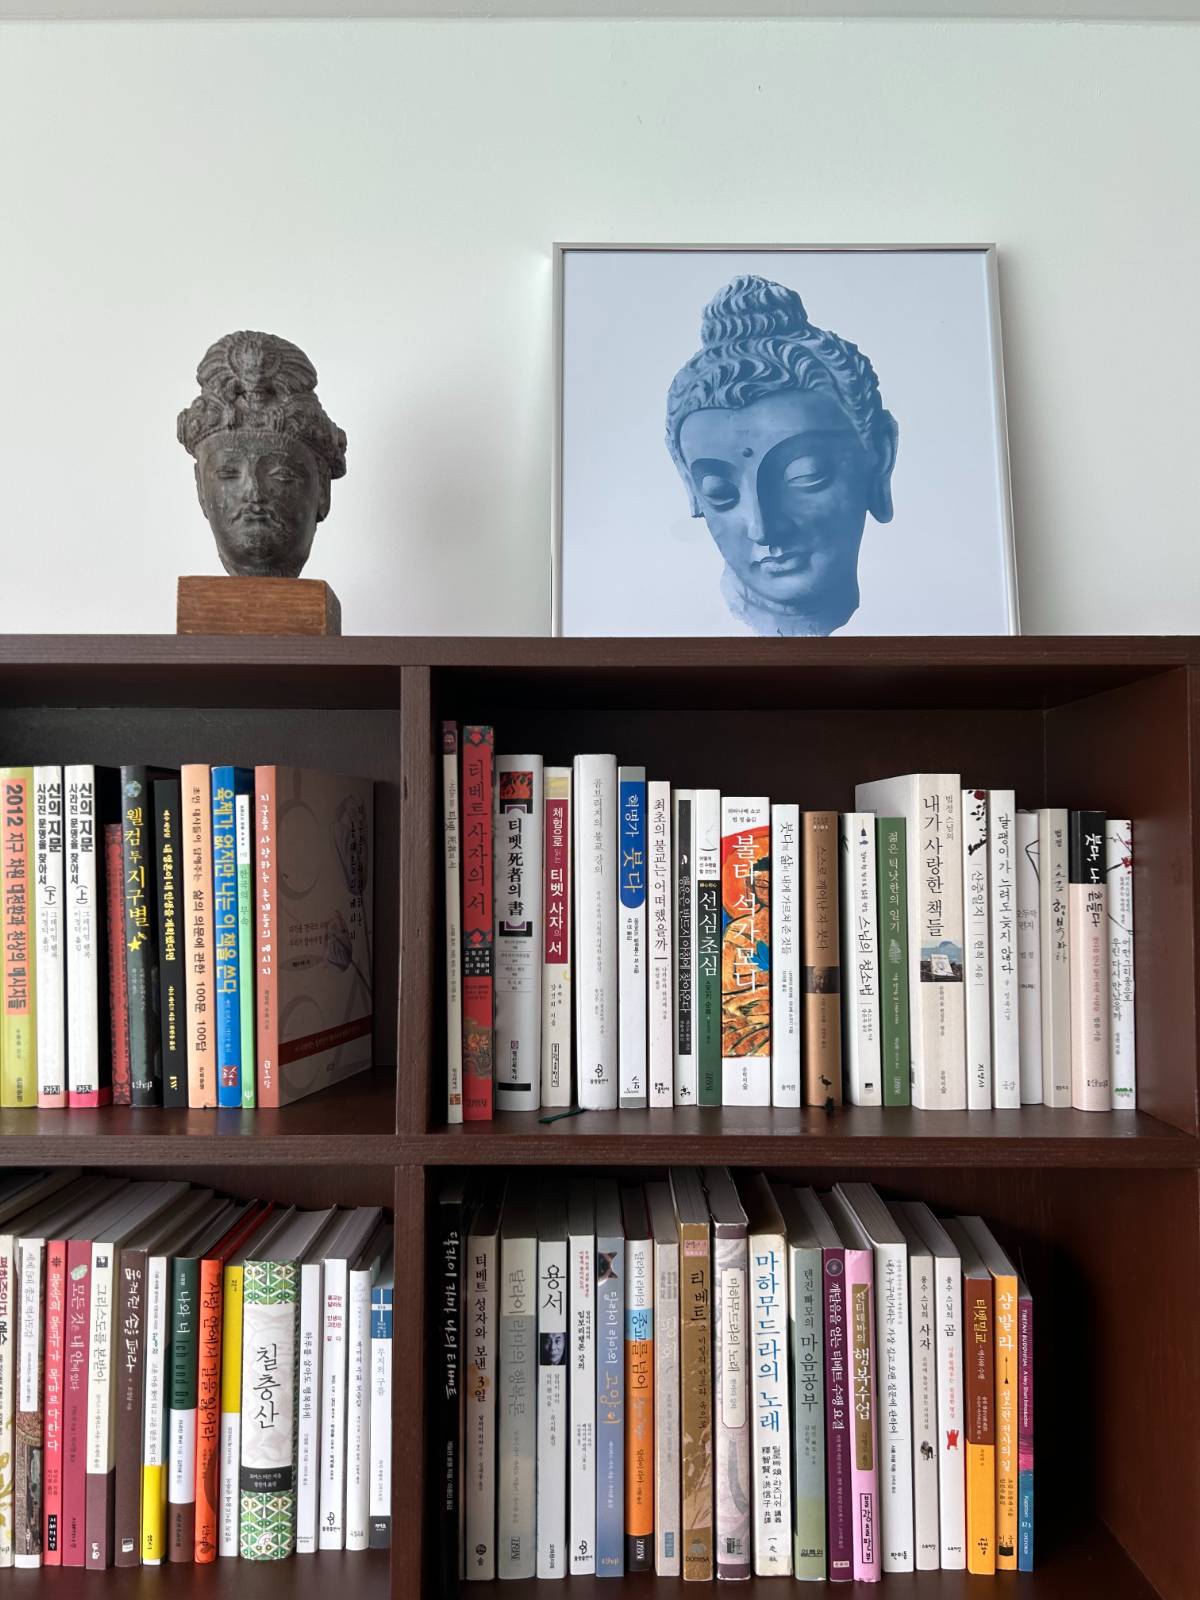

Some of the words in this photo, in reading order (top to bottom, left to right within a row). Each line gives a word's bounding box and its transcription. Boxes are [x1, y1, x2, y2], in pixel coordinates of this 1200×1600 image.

[37, 784, 47, 815] 사라진
[47, 783, 61, 817] 신의
[69, 783, 78, 815] 사라진
[78, 783, 93, 816] 신의
[467, 759, 489, 817] 티베트
[6, 784, 24, 827] 2012
[214, 788, 234, 828] 육체가
[625, 794, 639, 837] 혁명가
[653, 798, 665, 836] 최초의
[923, 794, 942, 832] 내가
[5, 832, 24, 853] 지구
[38, 818, 47, 850] 문명을
[48, 819, 62, 853] 지문
[70, 818, 78, 850] 문명을
[80, 819, 93, 853] 지문
[508, 818, 522, 850] 티벳
[552, 808, 563, 846] 체험으로
[998, 812, 1012, 874] 달팽이가
[214, 834, 236, 878] 없지만
[467, 822, 488, 886] 사자의
[653, 840, 667, 876] 불교는
[889, 832, 898, 855] 젊은
[1085, 833, 1102, 863] 붓다,
[5, 858, 25, 879] 차원
[38, 853, 47, 885] 찾아서
[70, 853, 79, 885] 찾아서
[162, 854, 174, 880] 영혼이
[507, 852, 524, 898] 死者의
[623, 847, 643, 893] 붓다
[732, 834, 760, 886] 불타
[780, 854, 793, 872] 삶이
[924, 837, 944, 894] 사랑한
[164, 882, 174, 890] 내
[216, 882, 236, 912] 나는
[551, 869, 563, 896] 티벳
[678, 874, 692, 908] 행운은
[780, 875, 791, 892] 내게
[889, 858, 899, 908] 틱낫한의
[971, 870, 985, 917] 산중일지
[998, 878, 1012, 914] 느려도
[6, 884, 26, 930] 대전환과
[164, 892, 174, 916] 인생을
[468, 892, 486, 916] 서
[550, 902, 564, 938] 사자의
[654, 880, 668, 952] 어떠했을까
[781, 896, 791, 923] 가르쳐
[926, 899, 944, 937] 책들
[1087, 891, 1103, 928] 흔들다
[216, 914, 236, 928] 이
[678, 908, 692, 938] 반드시
[698, 890, 718, 976] 선심초심
[780, 924, 792, 934] 준
[858, 915, 873, 953] 스님의
[889, 910, 900, 933] 일기
[998, 916, 1012, 942] 늦지
[6, 930, 26, 962] 천상의
[164, 918, 176, 960] 계획했다면
[216, 932, 238, 960] 책을
[549, 945, 562, 956] 서
[678, 940, 692, 968] 아침에
[732, 892, 762, 994] 석가모니
[782, 936, 792, 954] 것들
[1000, 946, 1014, 974] 않다
[8, 966, 26, 1010] 메시지들
[216, 964, 238, 994] 쓴다
[678, 972, 692, 1012] 찾아온다
[858, 959, 874, 996] 청소법
[442, 1232, 460, 1276] 달라이
[634, 1251, 644, 1277] 달라이
[886, 1258, 894, 1276] 내가
[124, 1268, 142, 1310] 움켜쥔
[474, 1253, 487, 1293] 티베트
[804, 1269, 814, 1289] 텐진
[70, 1282, 86, 1310] 모든
[177, 1291, 191, 1316] 나와
[204, 1282, 220, 1312] 사랑
[444, 1282, 458, 1312] 라마
[509, 1269, 526, 1314] 달라이
[541, 1264, 565, 1316] 용서
[635, 1281, 644, 1307] 라마의
[690, 1270, 708, 1321] 티베트
[830, 1282, 842, 1324] 깨달음을
[886, 1278, 896, 1324] 누구인가라는
[70, 1312, 86, 1332] 것은
[94, 1282, 108, 1344] 그리스도를
[474, 1297, 488, 1340] 성자와
[604, 1291, 618, 1325] 달라이
[728, 1278, 740, 1346] 마하무드라의
[755, 1250, 781, 1383] 마하무드라의
[998, 1292, 1014, 1351] 샴발라
[124, 1314, 140, 1336] 손을
[176, 1322, 190, 1333] 너
[202, 1316, 220, 1358] 안에서
[444, 1320, 458, 1348] 나의
[631, 1312, 648, 1358] 종교를
[830, 1327, 842, 1347] 얻는
[888, 1328, 896, 1342] 가장
[70, 1336, 84, 1348] 내
[126, 1338, 138, 1372] 펴라
[176, 1340, 190, 1356] Ich
[303, 1332, 313, 1354] 하루를
[474, 1345, 488, 1370] 보낸
[509, 1320, 526, 1364] 라마의
[604, 1330, 618, 1364] 라마의
[886, 1346, 896, 1362] 깊고
[70, 1350, 84, 1372] 안에
[92, 1348, 108, 1384] 본받아
[176, 1364, 187, 1385] und
[303, 1360, 313, 1381] 살아도
[444, 1354, 458, 1400] 티베트
[632, 1360, 649, 1389] 넘어
[728, 1350, 740, 1372] 노래
[800, 1332, 820, 1412] 마음공부
[831, 1351, 842, 1383] 티베트
[888, 1364, 896, 1380] 오랜
[70, 1372, 80, 1392] 있다
[202, 1364, 218, 1394] 길을
[252, 1342, 282, 1430] 칠층산
[474, 1376, 486, 1402] 3일
[508, 1370, 526, 1416] 행복론
[831, 1384, 844, 1406] 수행
[888, 1384, 898, 1406] 질문에
[175, 1391, 189, 1404] Du
[303, 1385, 312, 1419] 행복하게
[758, 1392, 782, 1432] 노래
[200, 1396, 216, 1442] 잃어라
[832, 1408, 844, 1428] 요결
[888, 1408, 898, 1434] 관하여
